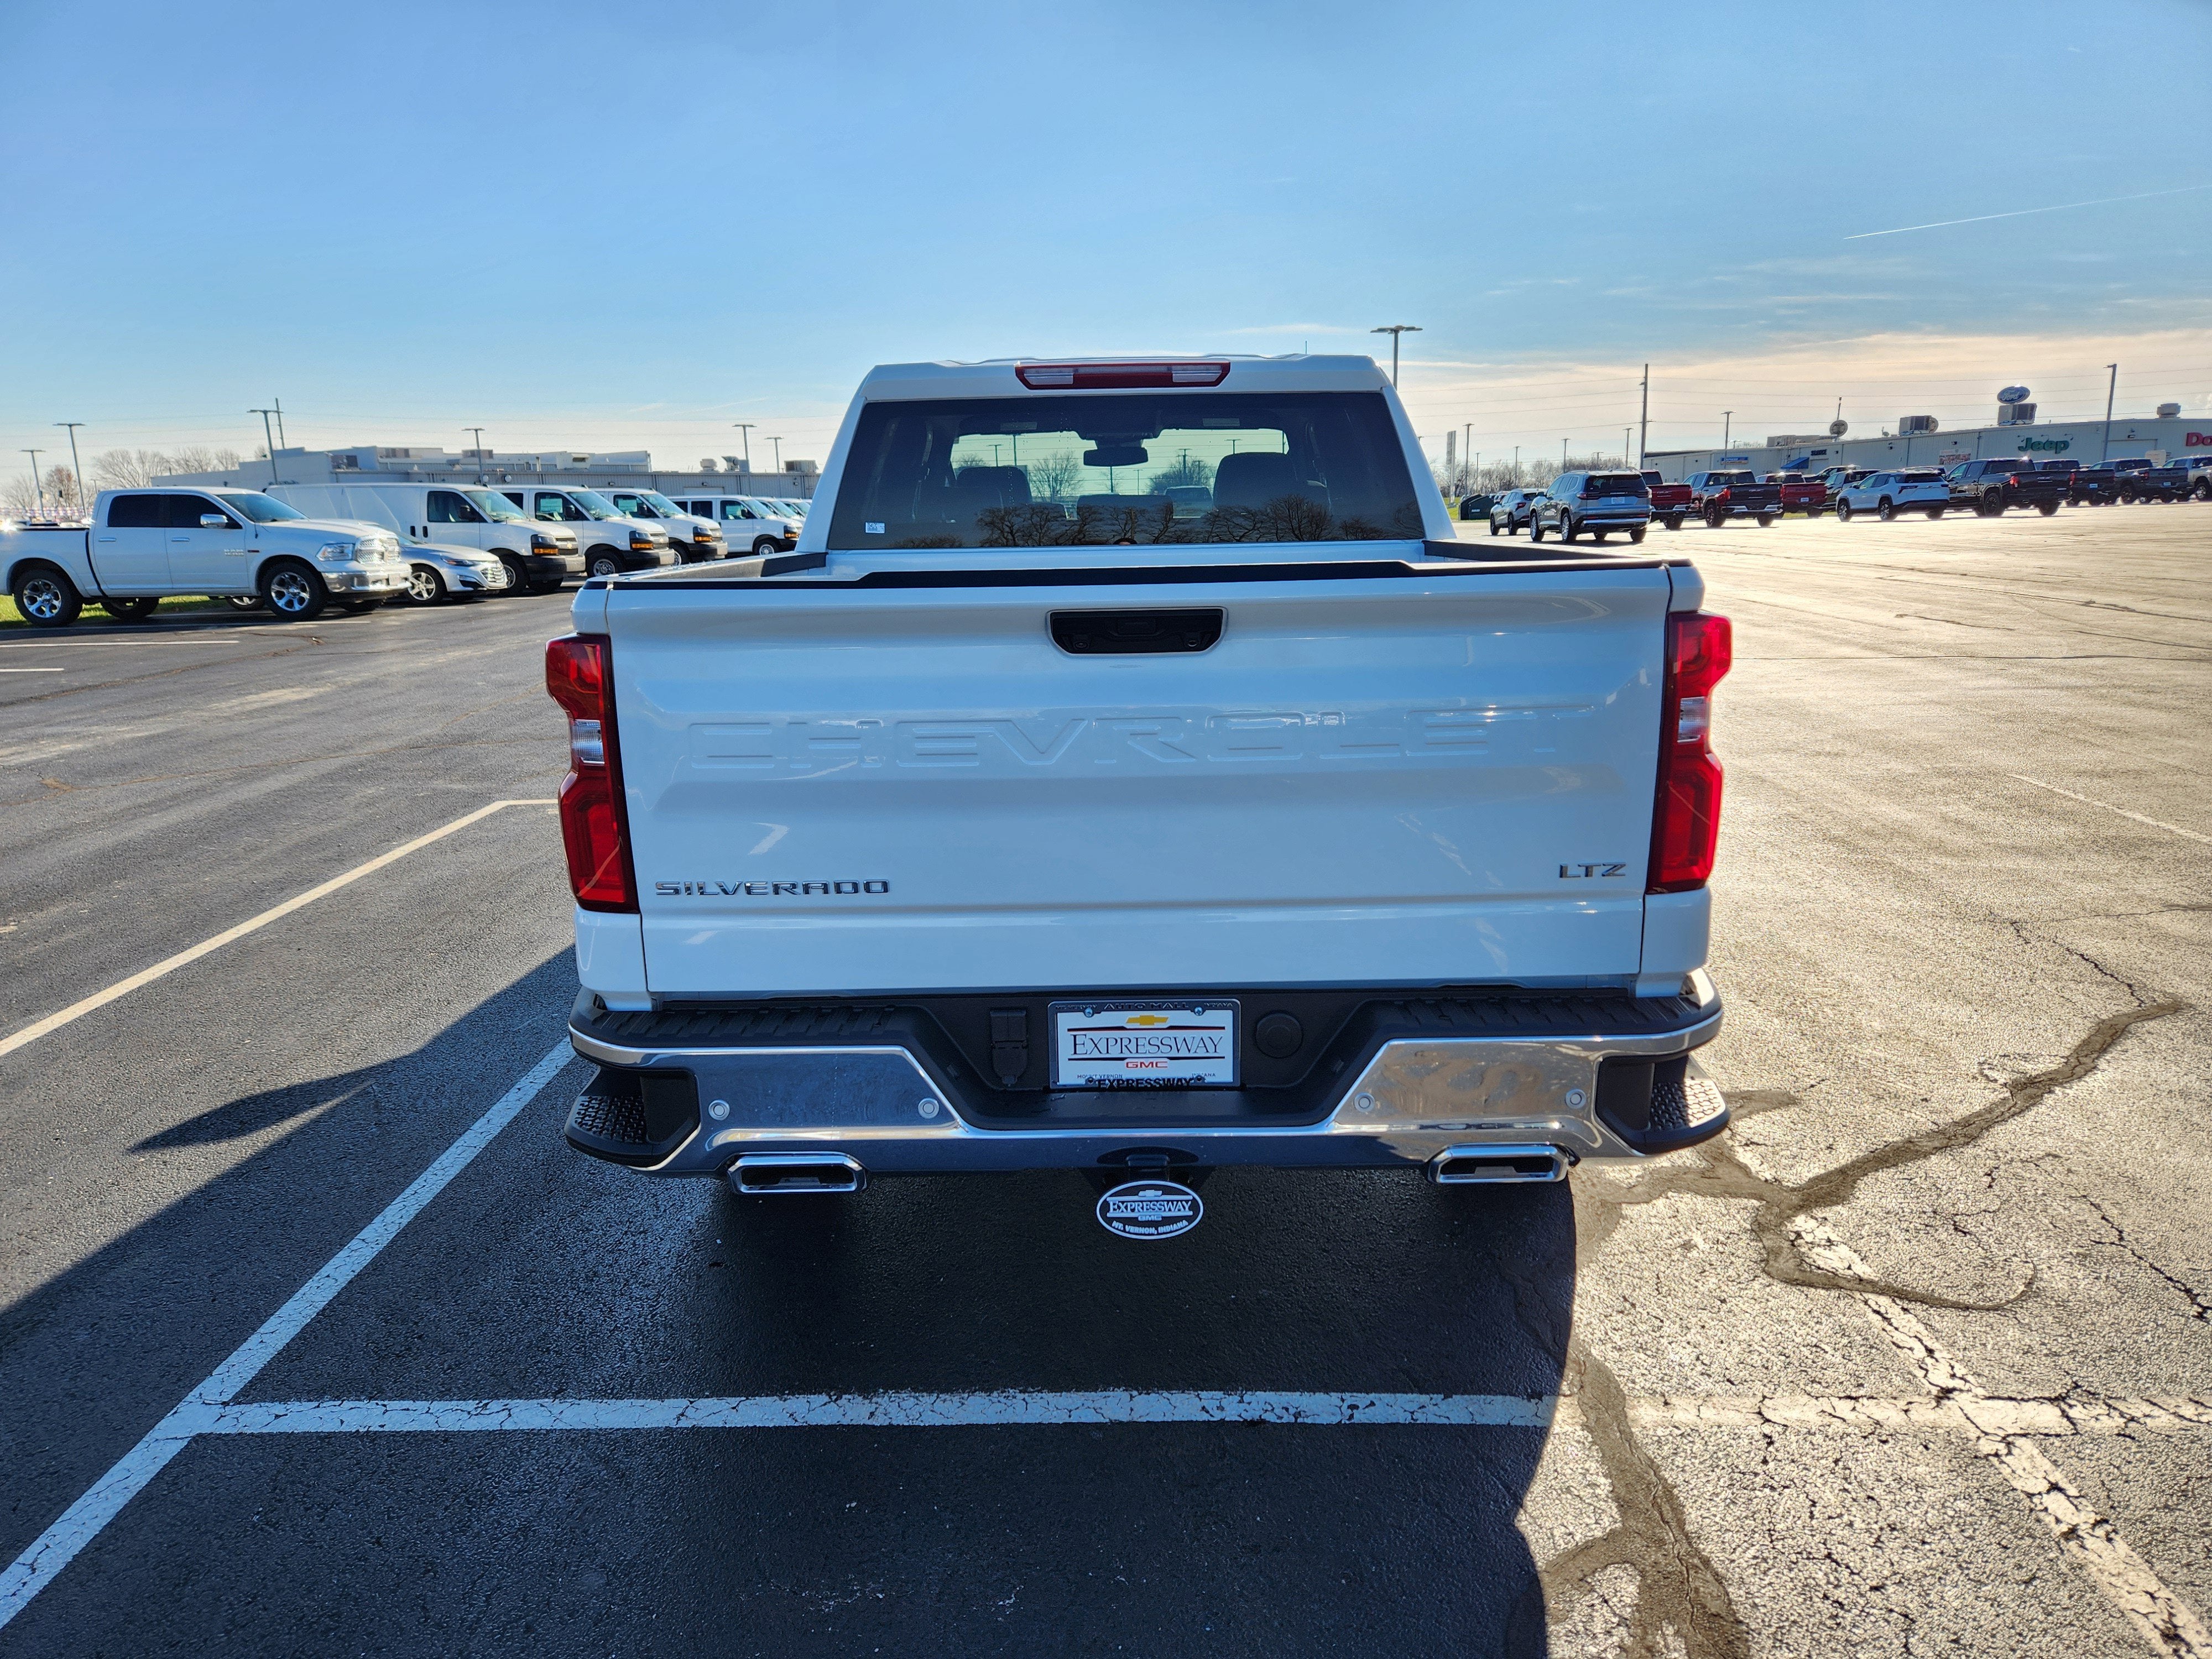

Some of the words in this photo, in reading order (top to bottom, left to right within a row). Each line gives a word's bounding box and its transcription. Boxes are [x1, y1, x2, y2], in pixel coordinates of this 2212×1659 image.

[2000, 389, 2020, 401] Ford
[2018, 437, 2069, 454] Jeep
[690, 703, 1594, 769] CHEVROLET
[1559, 862, 1626, 878] LTZ
[655, 879, 890, 896] SILVERADO
[1070, 1034, 1223, 1056] EXPRESSWAY
[1125, 1061, 1168, 1069] GMC
[1097, 1077, 1193, 1089] EXPRESSWAY
[1108, 1200, 1192, 1213] EXPRESSWAY
[1112, 1220, 1124, 1231] MT.
[1125, 1224, 1157, 1235] VERNON,
[1158, 1219, 1189, 1234] INDIANA
